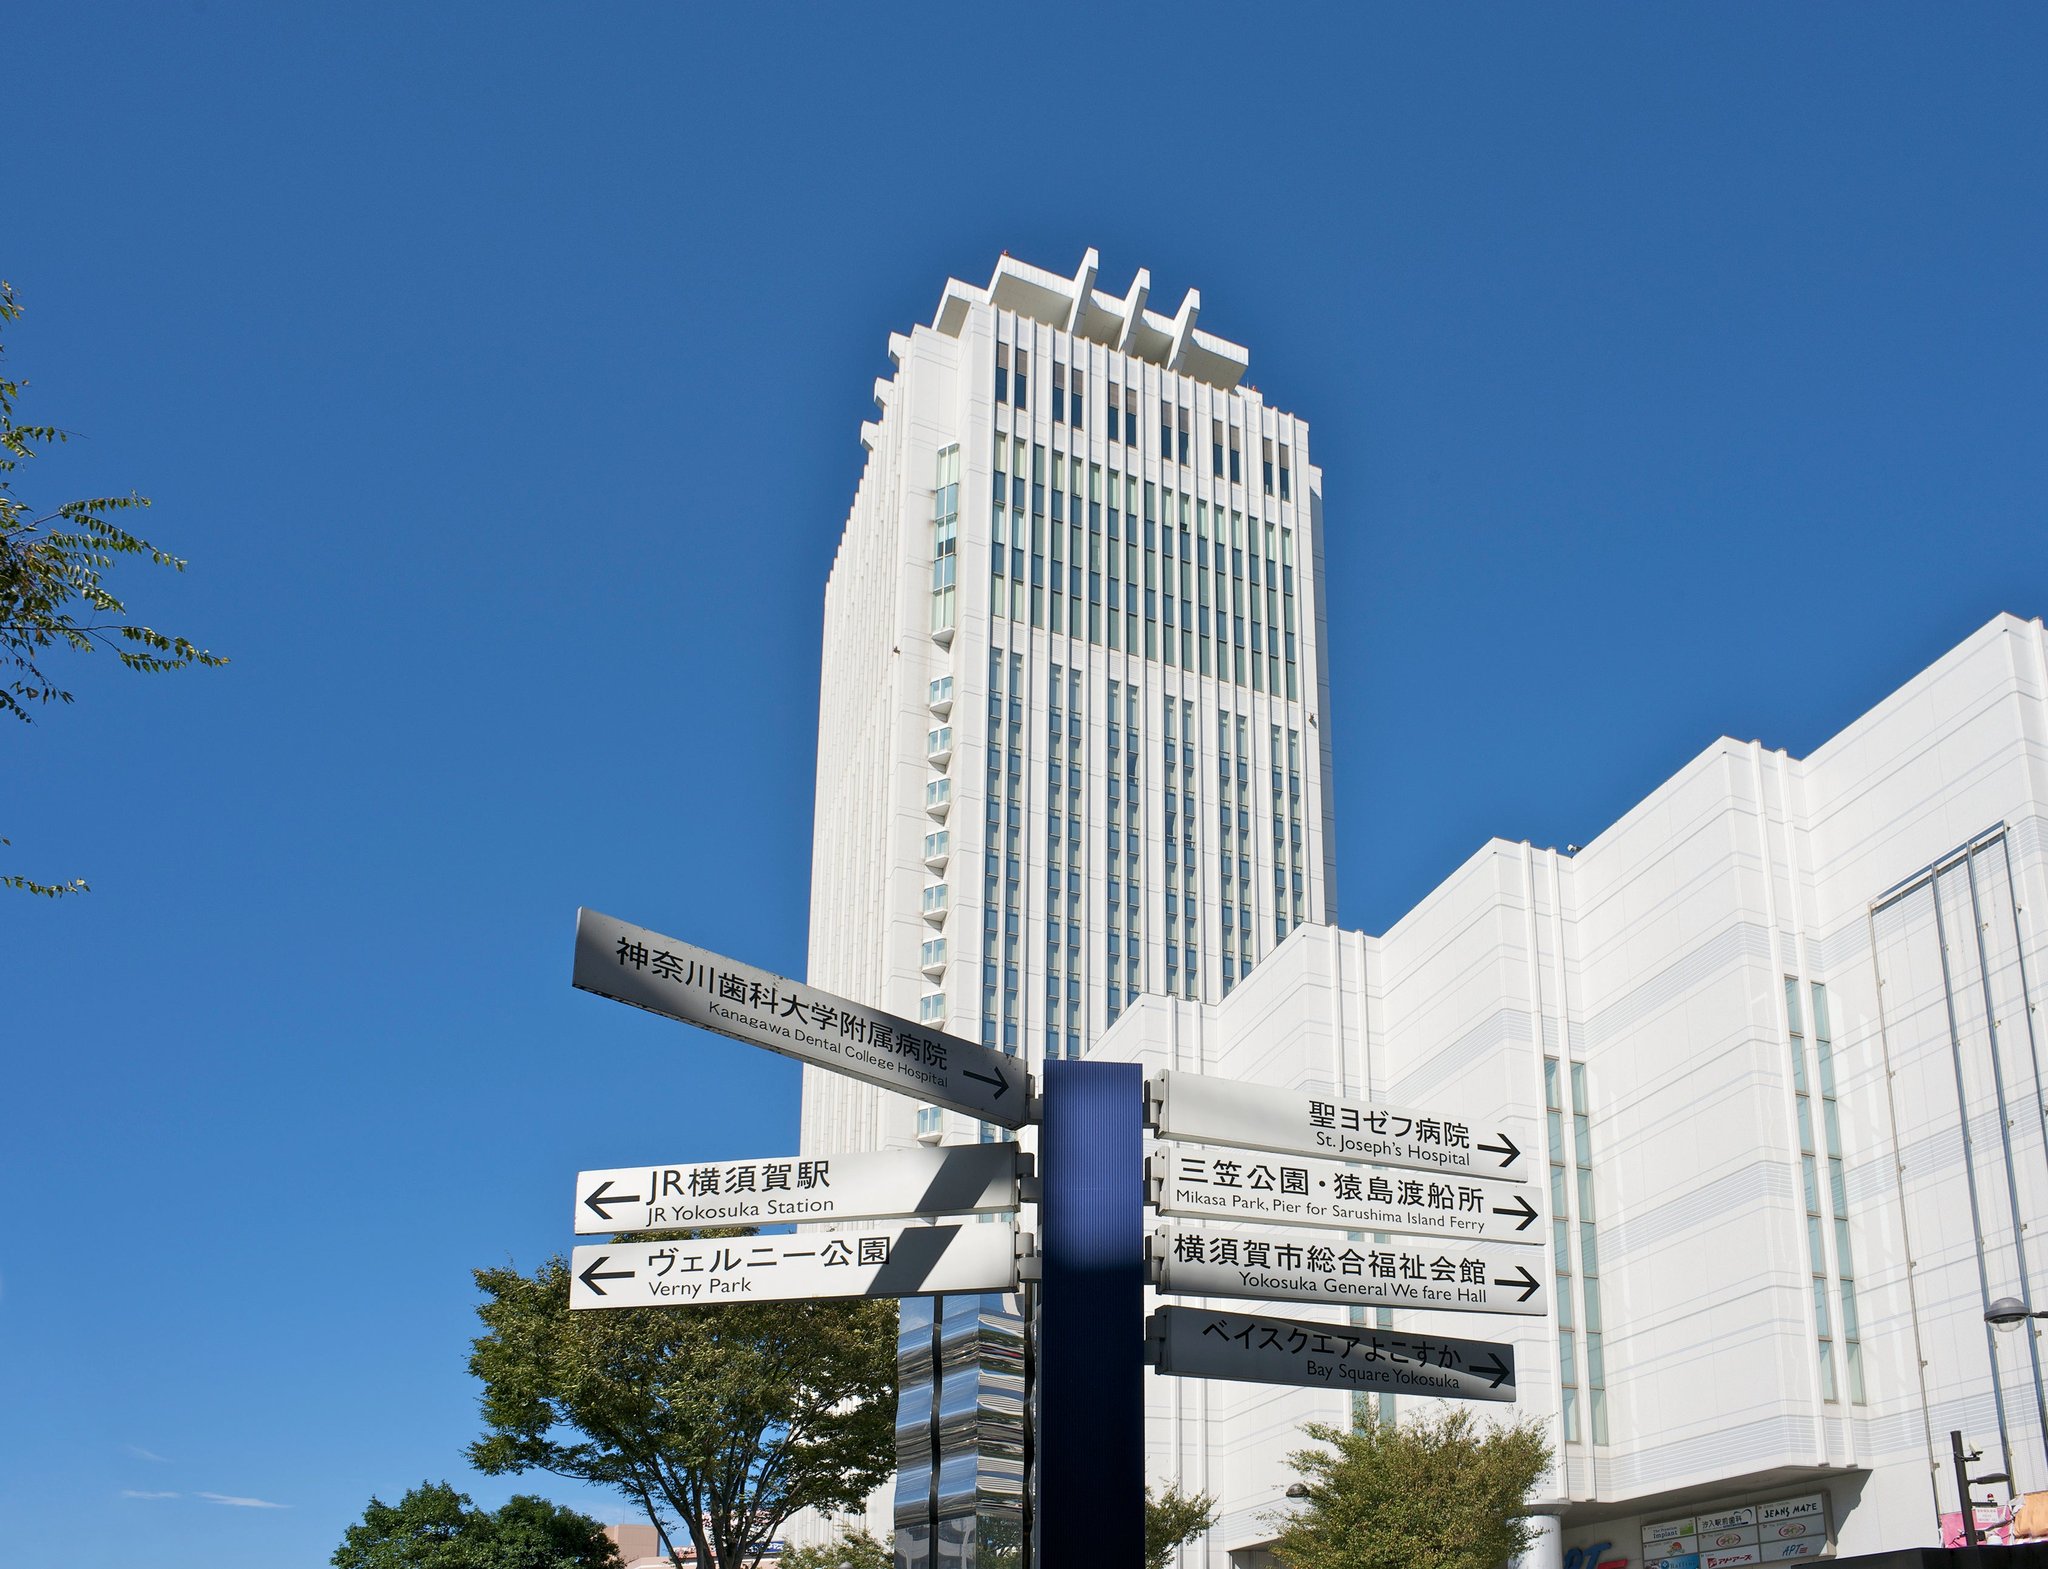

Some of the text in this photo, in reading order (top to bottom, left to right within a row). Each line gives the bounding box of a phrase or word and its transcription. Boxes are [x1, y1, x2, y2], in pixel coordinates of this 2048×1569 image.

[615, 935, 949, 1071] 神奈川歯科大学附属病院
[708, 1000, 949, 1089] Kanagawa Dental College Hospital
[1308, 1100, 1470, 1150] 聖ヨゼフ病院
[1316, 1131, 1471, 1167] St. Joseph's Hospital
[645, 1160, 831, 1206] JR横須賀駅
[1178, 1157, 1485, 1214] 三笠公園・猿島渡船所
[645, 1197, 834, 1228] JR Yokosuka Station
[1176, 1188, 1485, 1234] Mikasa Park, Pier for Sarushima Island Ferry
[648, 1235, 891, 1277] ヴェルニー公園
[1173, 1232, 1486, 1286] 横須賀市総合福祉会館
[648, 1277, 752, 1300] Verny Park
[1238, 1271, 1318, 1293] Yokosuka
[1323, 1278, 1388, 1297] General
[1457, 1287, 1487, 1304] Hall
[1202, 1319, 1463, 1368] ベイスクエアよこすか
[1306, 1359, 1460, 1390] Bay Square Yokosuka
[1764, 1509, 1790, 1518] JEANS
[1792, 1502, 1817, 1514] MATE
[1653, 1530, 1678, 1539] Implant
